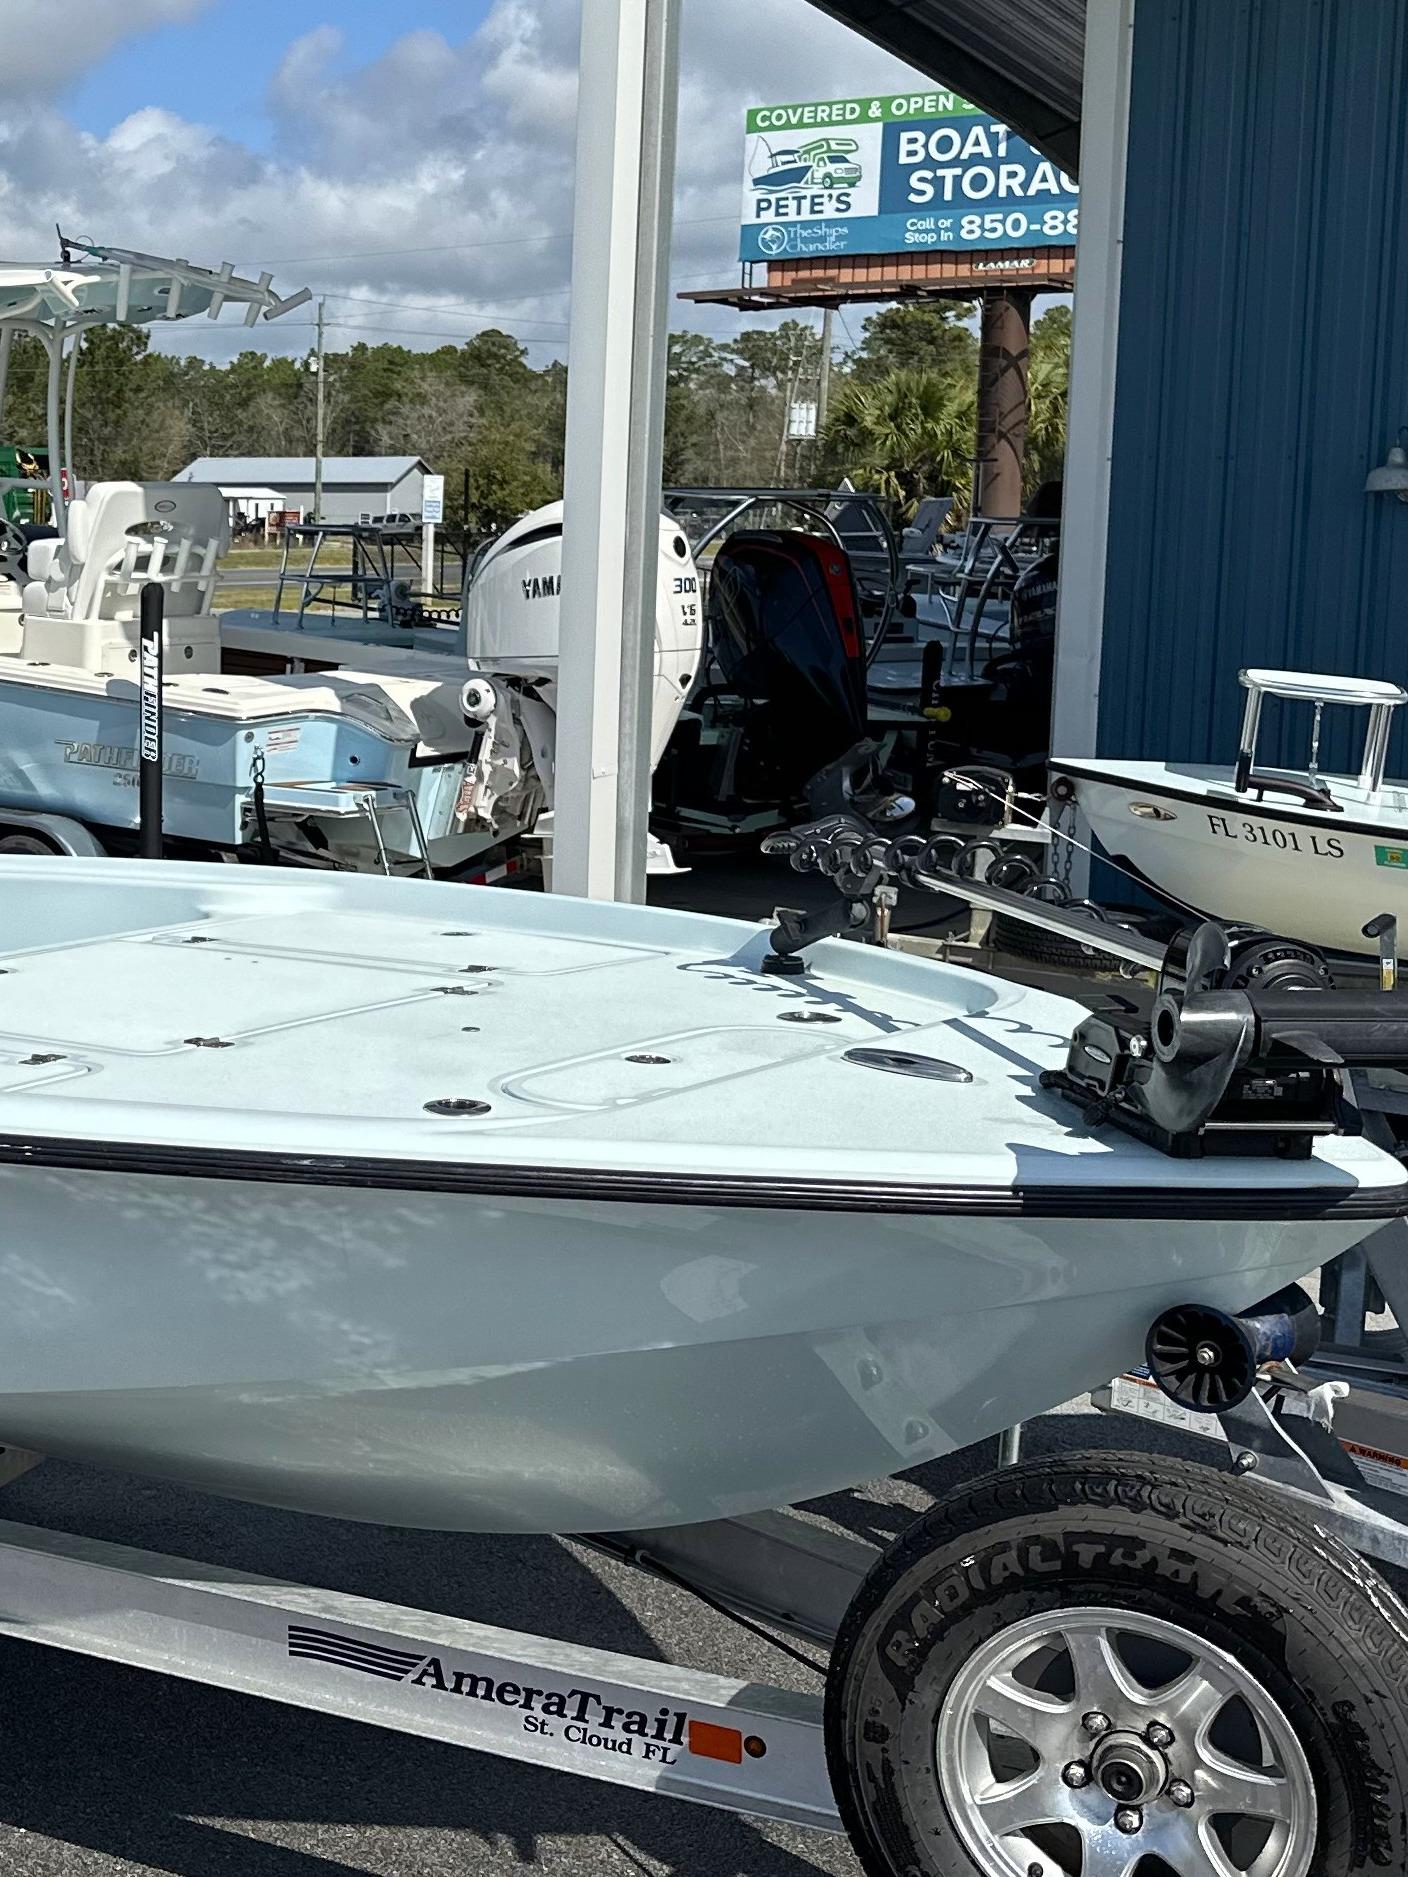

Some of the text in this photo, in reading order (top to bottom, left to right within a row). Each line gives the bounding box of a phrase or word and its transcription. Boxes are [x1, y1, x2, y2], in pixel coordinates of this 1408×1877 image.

[755, 102, 860, 127] COVERED
[867, 100, 883, 118] &
[891, 94, 954, 115] OPEN
[897, 124, 1011, 165] BOAT
[755, 192, 852, 219] PETE'S
[906, 217, 953, 230] Call or
[785, 237, 848, 252] Chandler
[904, 231, 937, 245] Stop
[978, 258, 1031, 271] LAMAR
[673, 577, 697, 594] 300
[142, 631, 159, 762] PATHFINDER
[1207, 814, 1344, 859] FL 3101 LS
[1359, 1448, 1402, 1467] WARNING
[410, 1656, 688, 1746] AmeraTrail
[523, 1714, 679, 1766] St. Cloud FL
